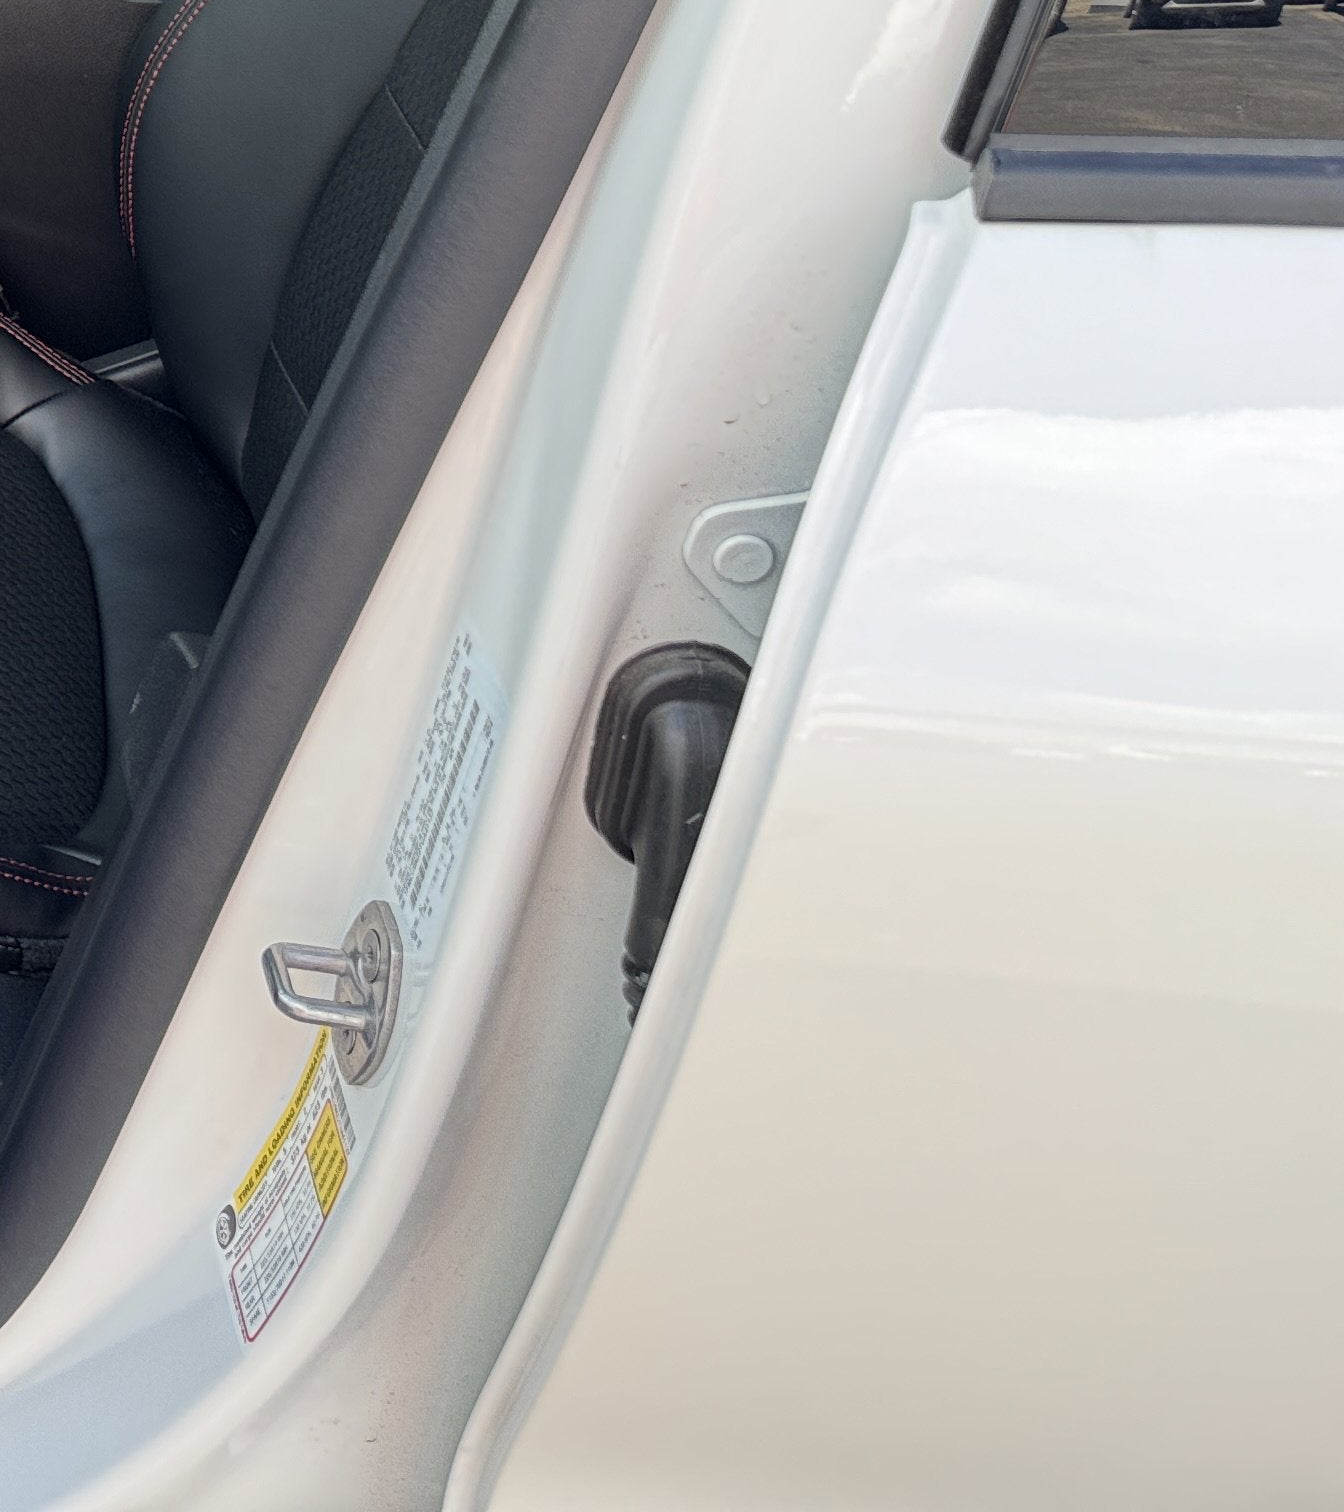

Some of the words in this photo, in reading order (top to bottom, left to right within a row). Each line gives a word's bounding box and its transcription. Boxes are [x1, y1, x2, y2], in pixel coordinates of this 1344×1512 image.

[238, 1177, 254, 1202] TIRE
[255, 1154, 268, 1178] AND
[268, 1108, 294, 1155] LOADING
[294, 1029, 327, 1108] INFORMATION
